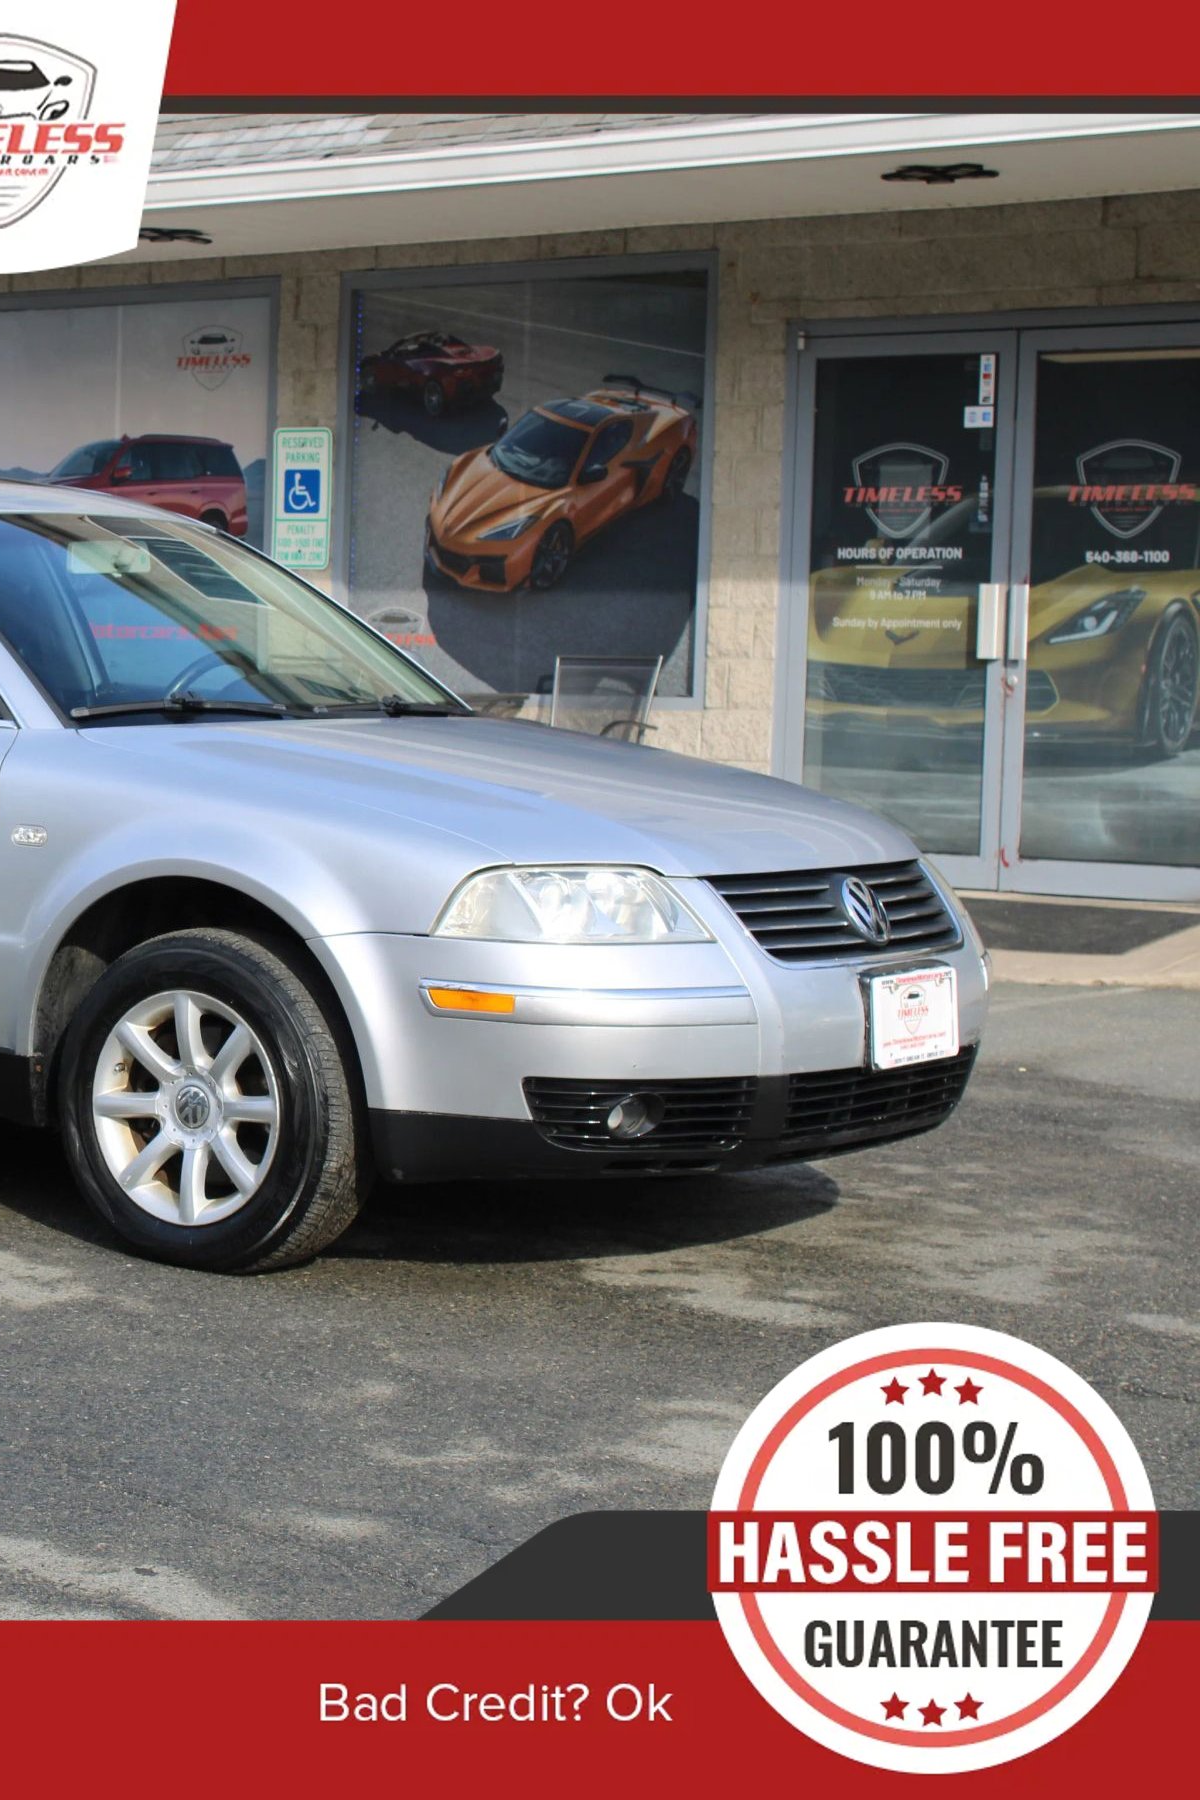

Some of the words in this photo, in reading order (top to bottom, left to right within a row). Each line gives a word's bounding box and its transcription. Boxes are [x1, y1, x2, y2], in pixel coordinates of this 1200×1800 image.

[176, 353, 252, 369] TIMELESS
[282, 436, 325, 449] RESERVED
[286, 452, 320, 463] PARKING
[843, 485, 963, 503] TIMELESS
[1067, 484, 1197, 502] TIMELESS
[837, 547, 877, 560] HOURS
[878, 547, 895, 560] OF
[896, 547, 963, 560] OPERATION
[1085, 550, 1171, 563] 540-368-1100
[856, 576, 891, 589] Monday
[899, 576, 941, 589] Saturday
[876, 591, 892, 600] AM
[832, 616, 866, 629] Sunday
[868, 617, 878, 629] by
[881, 617, 941, 630] Appointment
[942, 618, 963, 631] only
